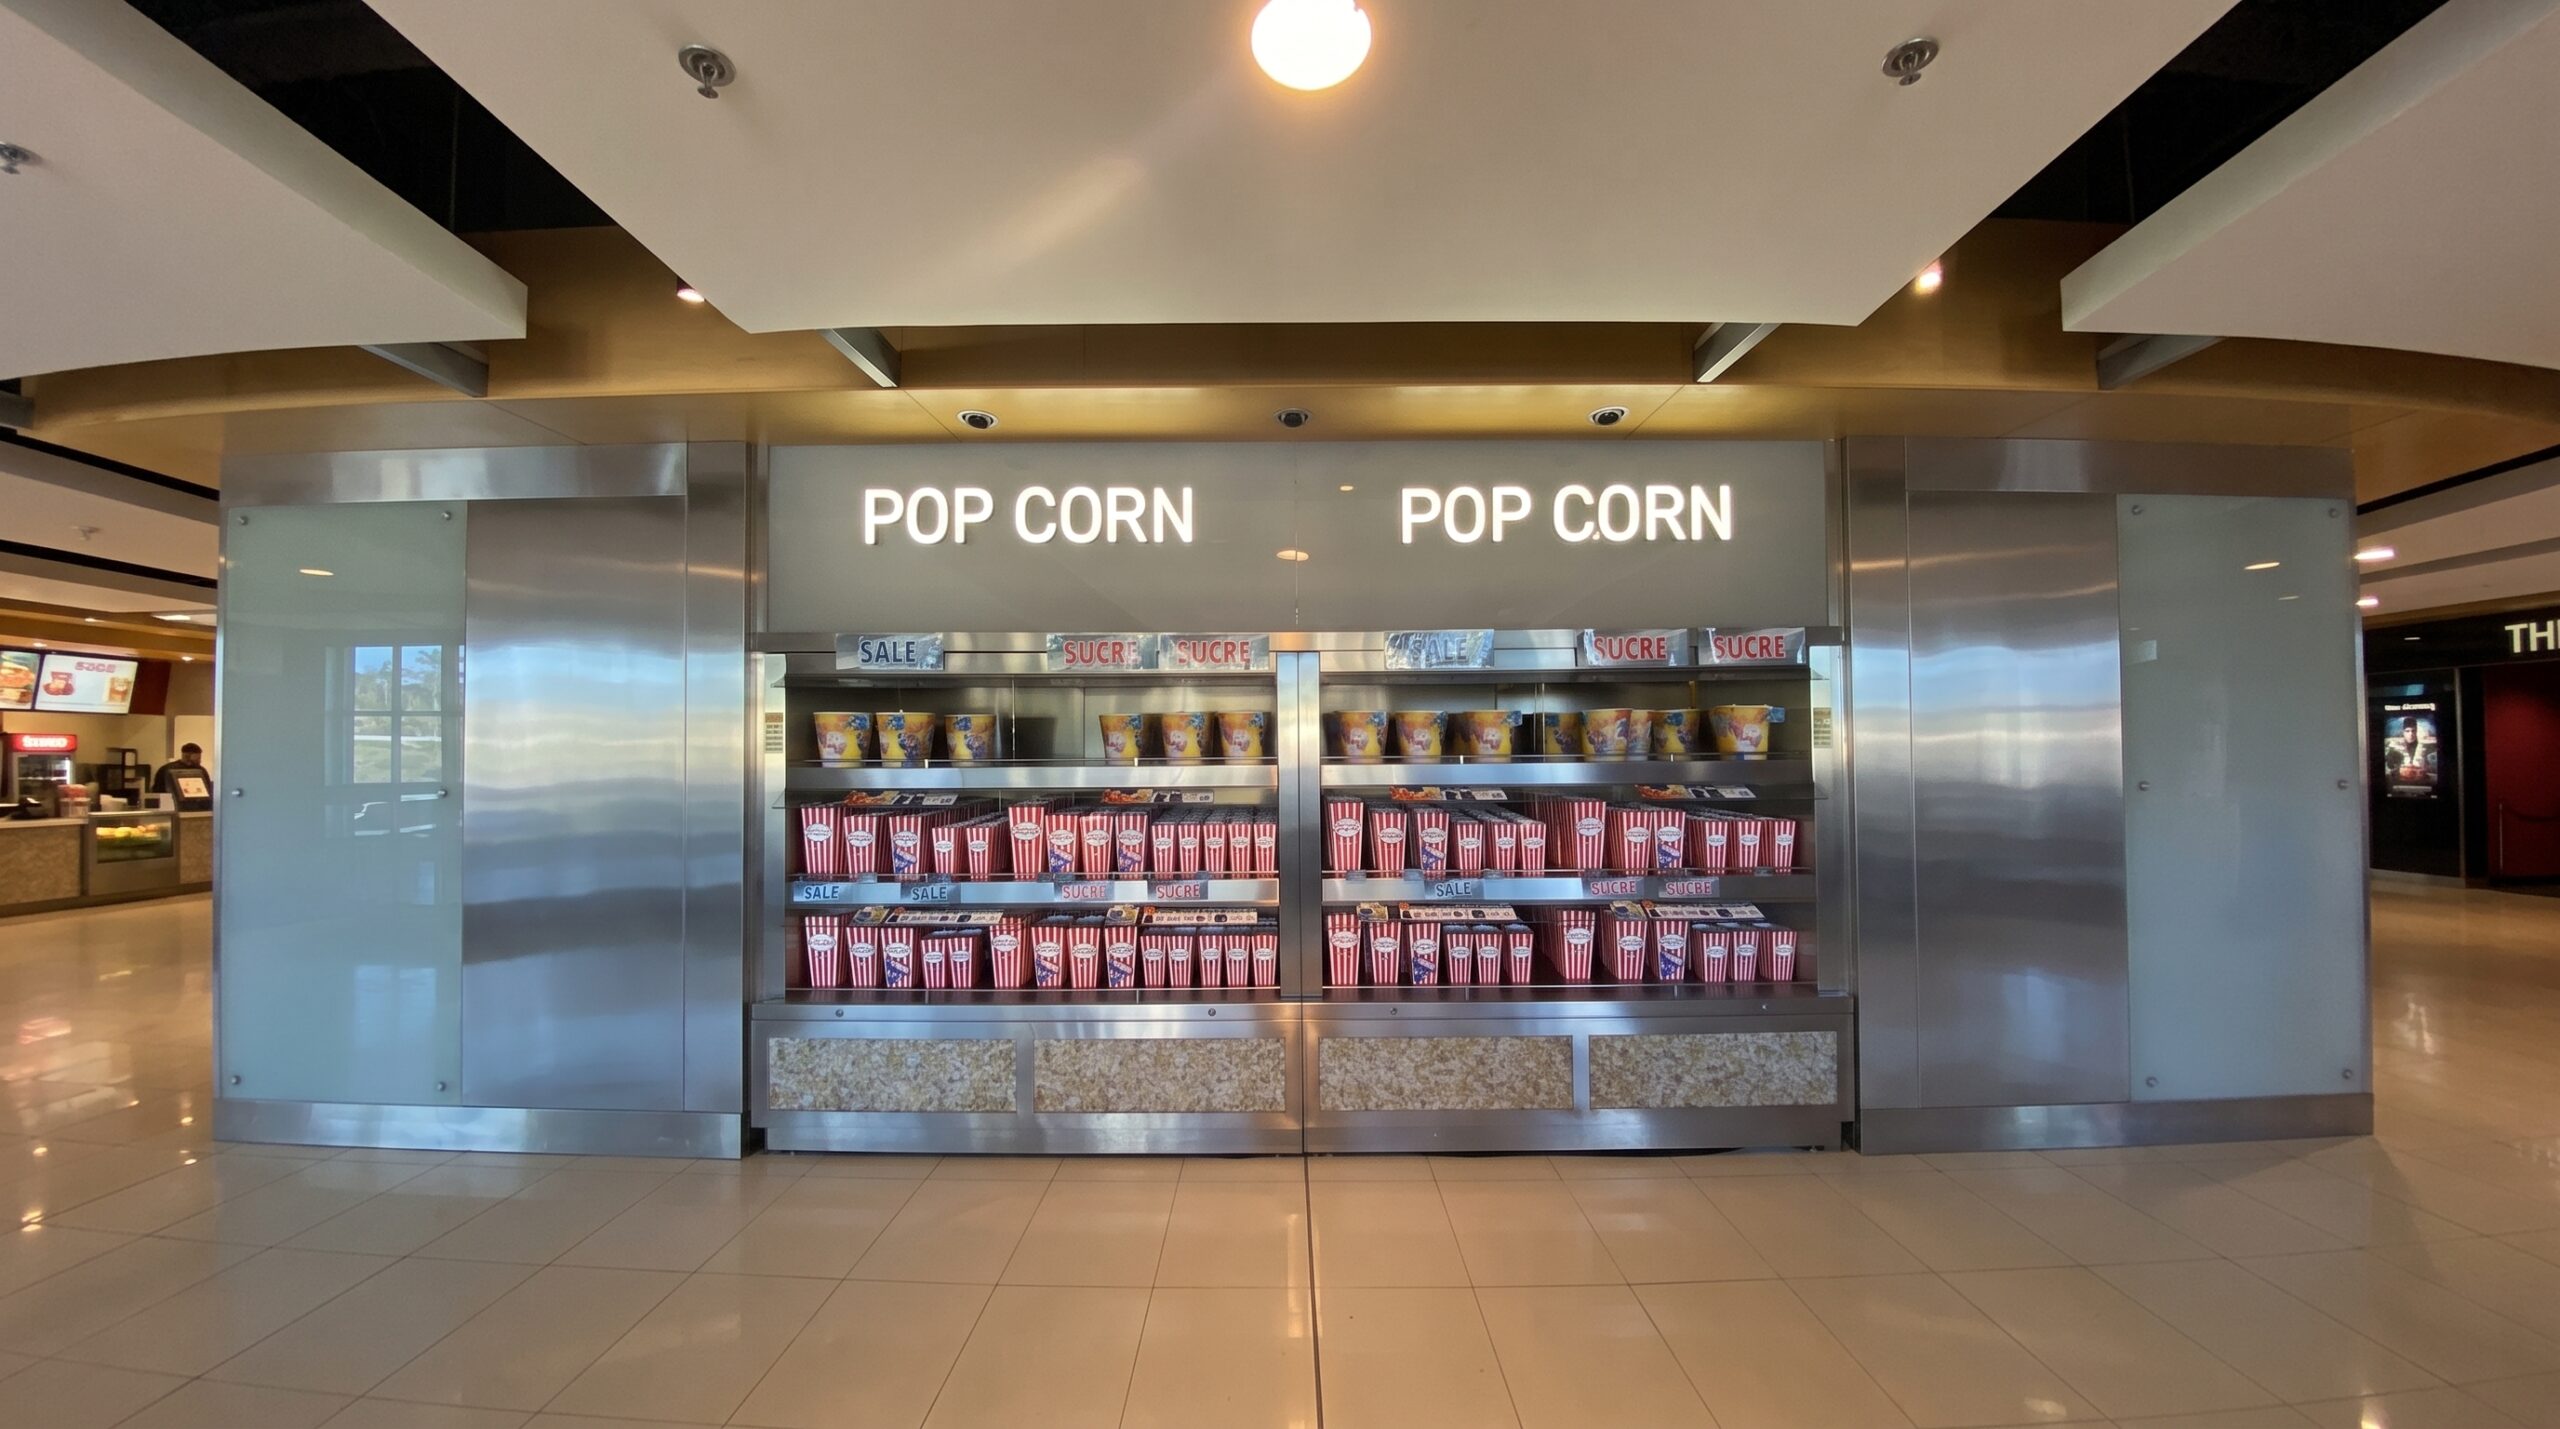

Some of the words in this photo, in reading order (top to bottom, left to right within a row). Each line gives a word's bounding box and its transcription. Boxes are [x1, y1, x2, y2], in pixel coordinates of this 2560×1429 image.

[864, 488, 994, 545] POP
[1014, 486, 1194, 544] CORN
[1401, 486, 1532, 544] POP
[1553, 484, 1733, 543] CORN
[1593, 636, 1667, 660] SUCRE
[1713, 635, 1785, 659] SUCRE
[2504, 619, 2560, 654] TH
[860, 640, 916, 663] SALE
[1063, 640, 1138, 664] SUCRE
[1177, 640, 1251, 665] SUCRE
[1411, 638, 1469, 662] SALE
[804, 885, 839, 900] SALE
[912, 886, 947, 901] SALE
[1062, 885, 1106, 899] SUCRE
[1157, 884, 1200, 899] SUCRE
[1436, 882, 1472, 897] SALE
[1591, 881, 1637, 895] SUCRE
